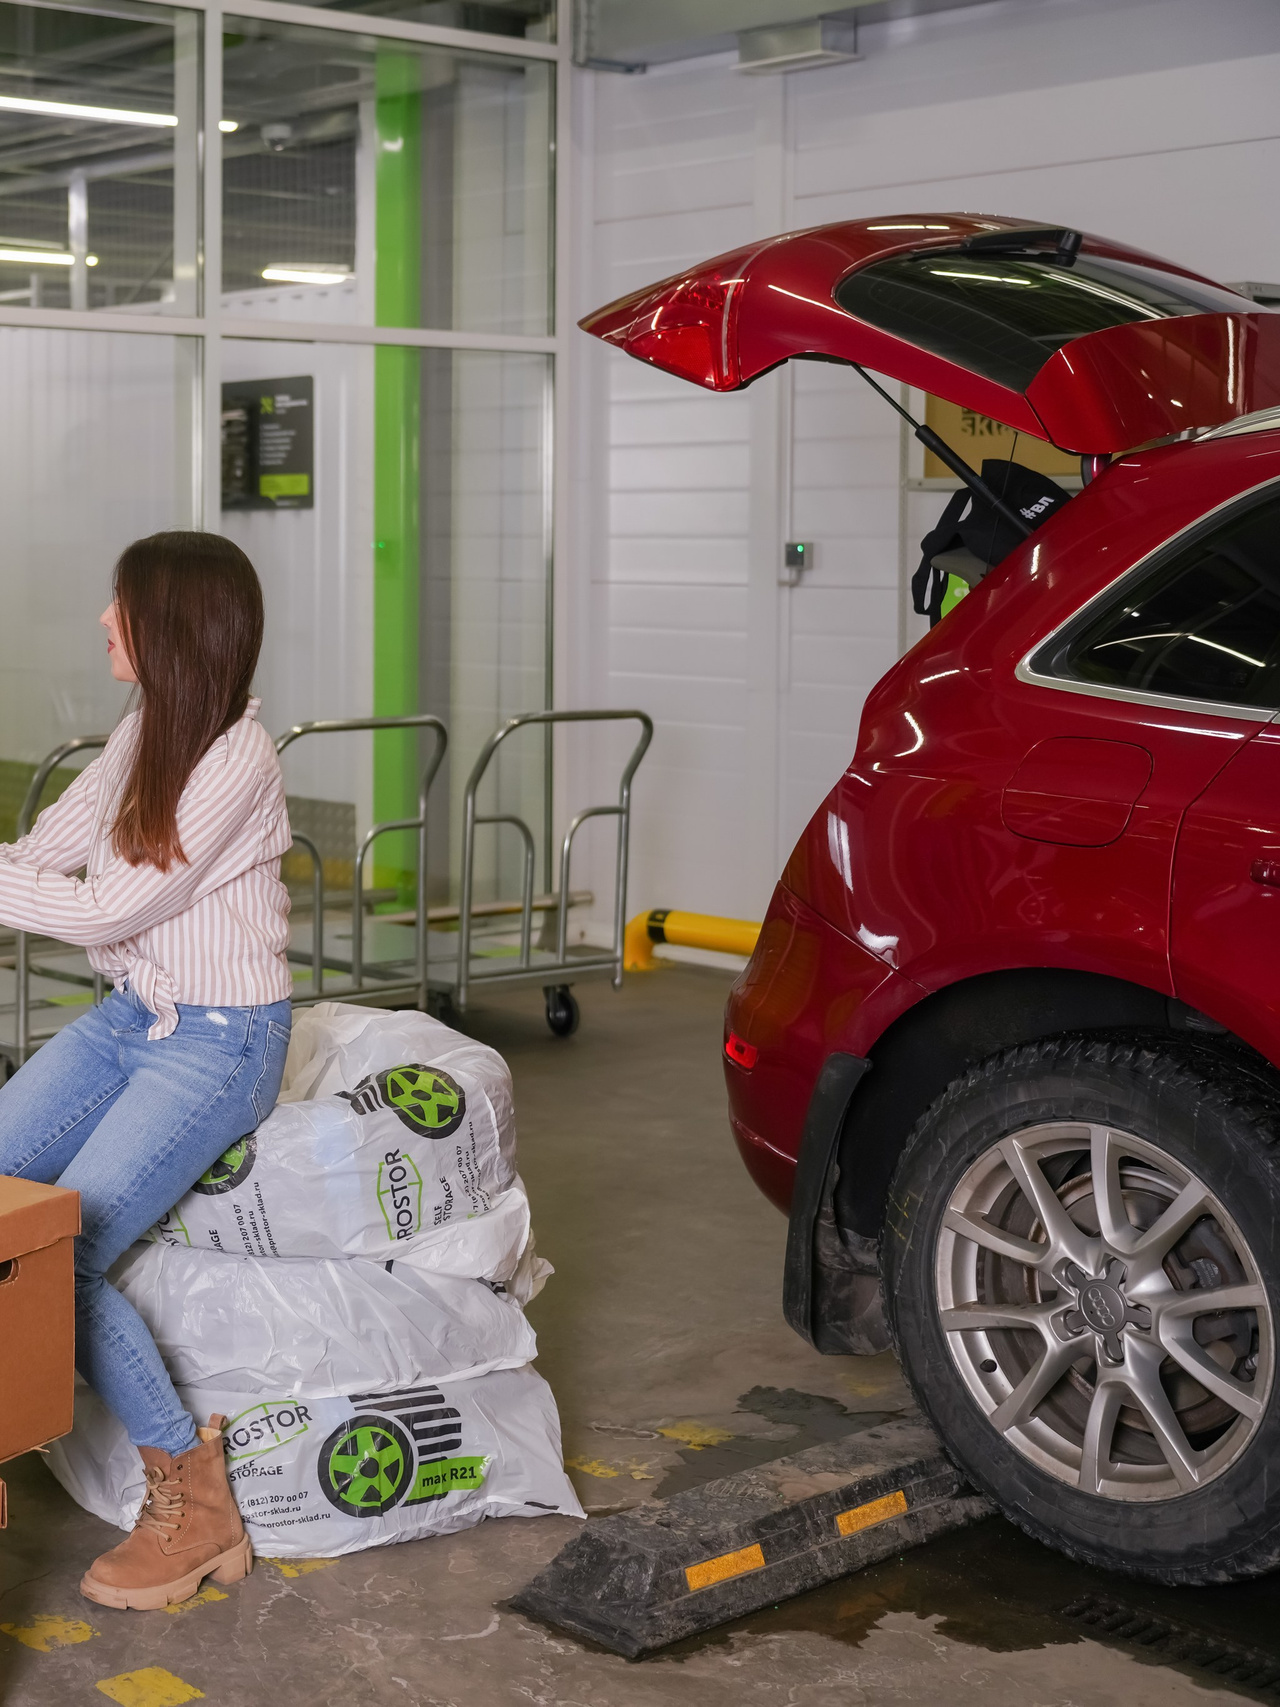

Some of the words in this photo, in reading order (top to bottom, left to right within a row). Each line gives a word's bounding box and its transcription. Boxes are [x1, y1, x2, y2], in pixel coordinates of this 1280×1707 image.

[384, 1148, 415, 1241] ROSTOR
[439, 1175, 454, 1222] STORAGE
[233, 1204, 241, 1214] 07
[434, 1206, 442, 1226] SELF
[236, 1215, 245, 1226] 00
[239, 1227, 250, 1242] 207
[222, 1405, 313, 1455] ROSTOR
[229, 1465, 284, 1482] STORAGE
[422, 1473, 447, 1487] max
[450, 1466, 477, 1481] R21
[247, 1497, 269, 1508] (812)
[269, 1495, 285, 1504] 207
[286, 1494, 297, 1503] 00
[298, 1490, 309, 1499] 07
